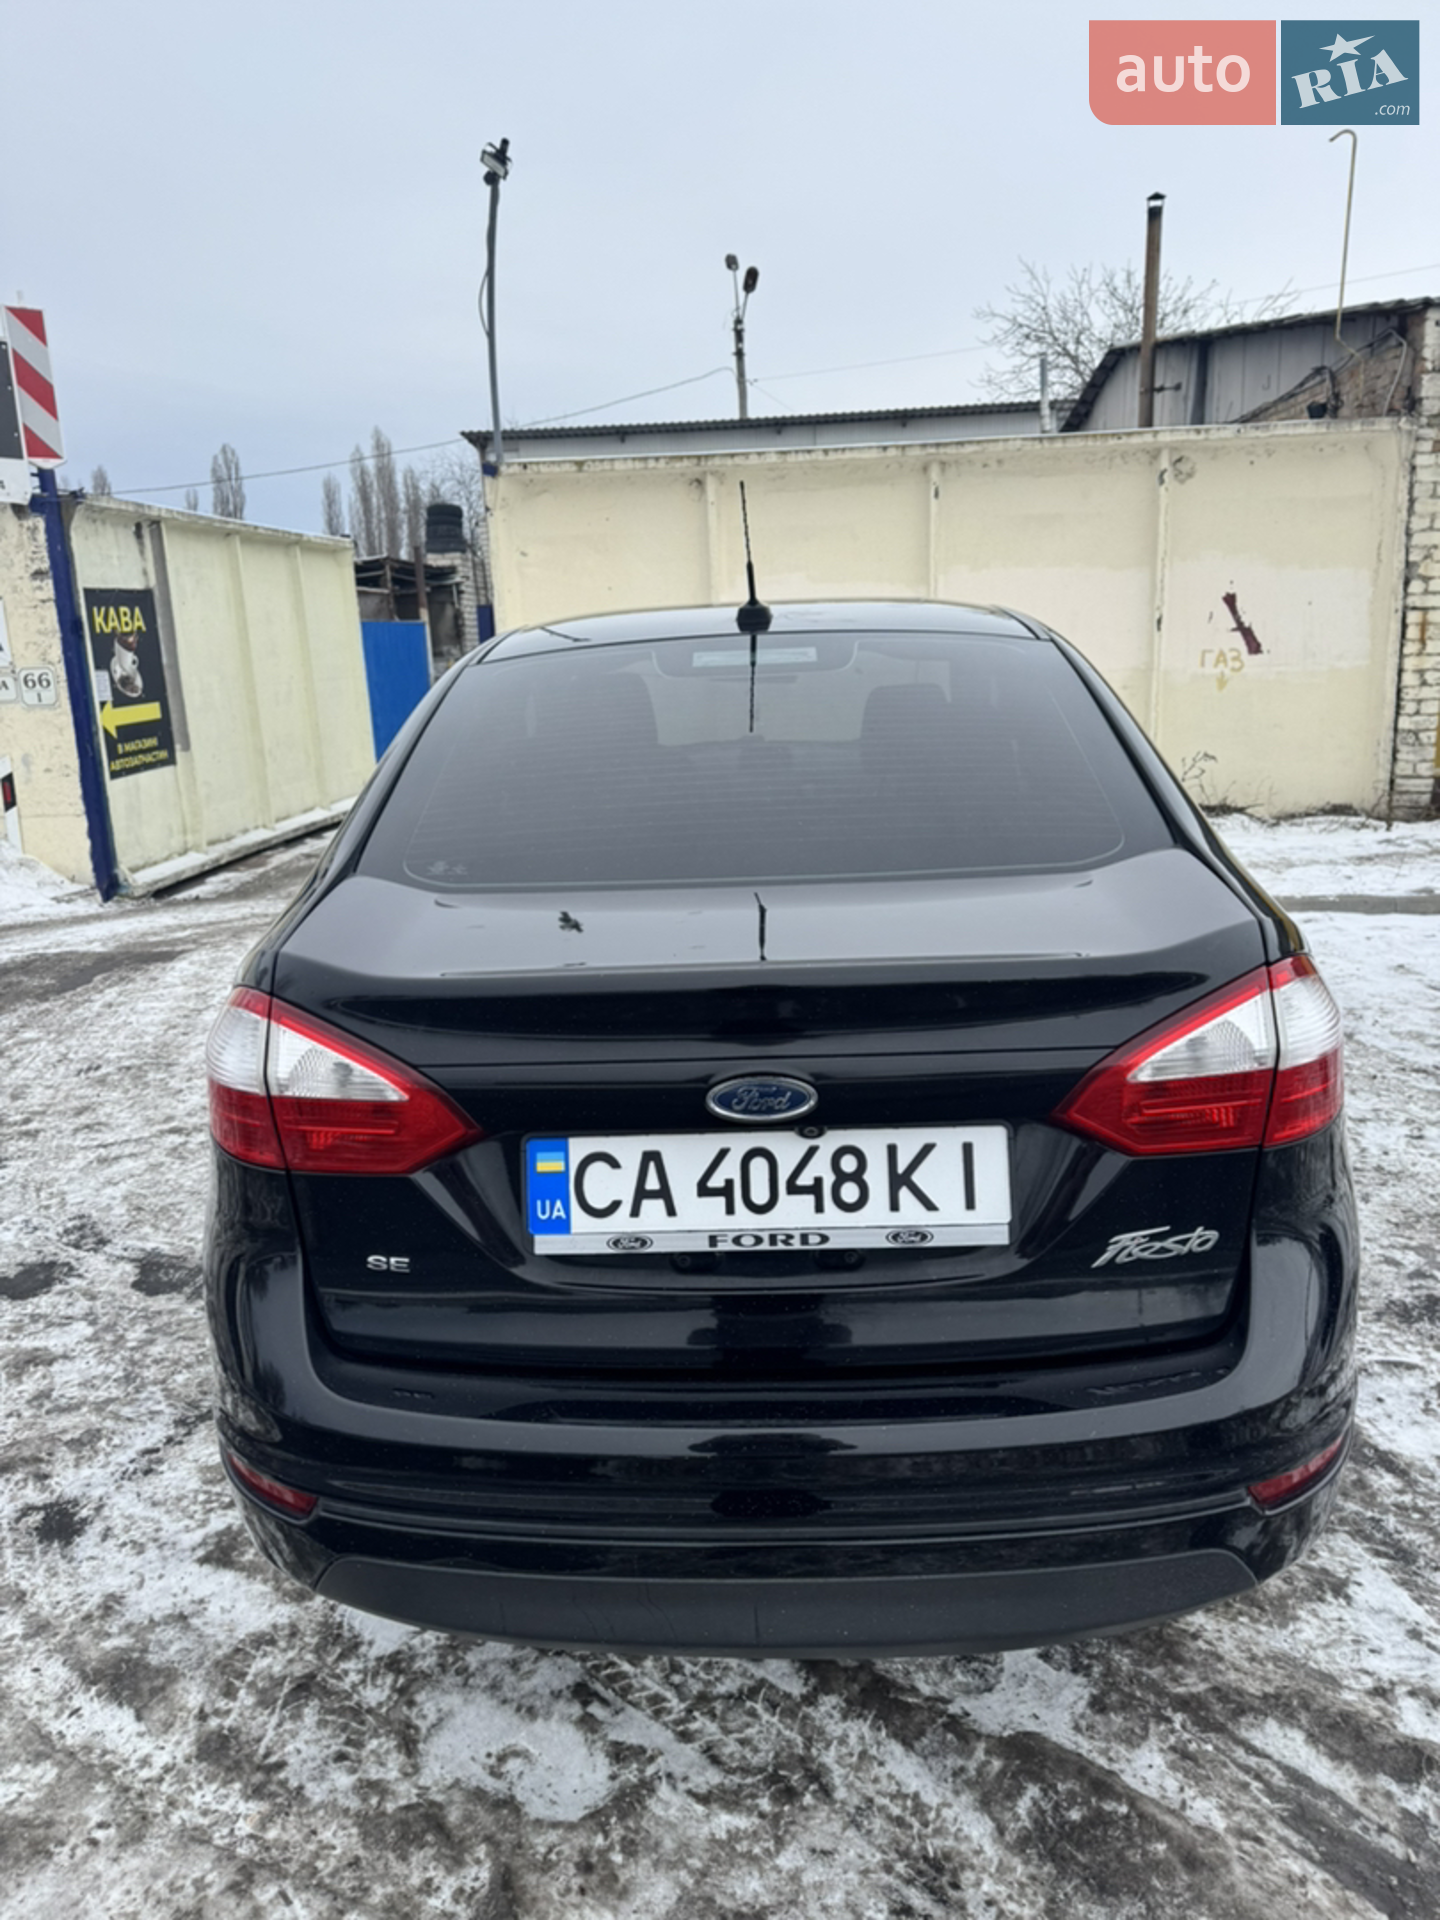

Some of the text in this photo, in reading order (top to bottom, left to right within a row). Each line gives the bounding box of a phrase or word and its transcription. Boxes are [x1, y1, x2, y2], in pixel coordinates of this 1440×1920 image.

[92, 606, 147, 633] КАВА
[1199, 647, 1246, 673] ГАЗ
[22, 671, 52, 690] 66
[731, 1085, 792, 1111] Ford
[574, 1141, 977, 1219] CA 4048 KI
[536, 1199, 567, 1220] UA
[708, 1231, 830, 1249] FORD
[1090, 1225, 1220, 1268] Fiesta
[366, 1254, 411, 1274] SE
